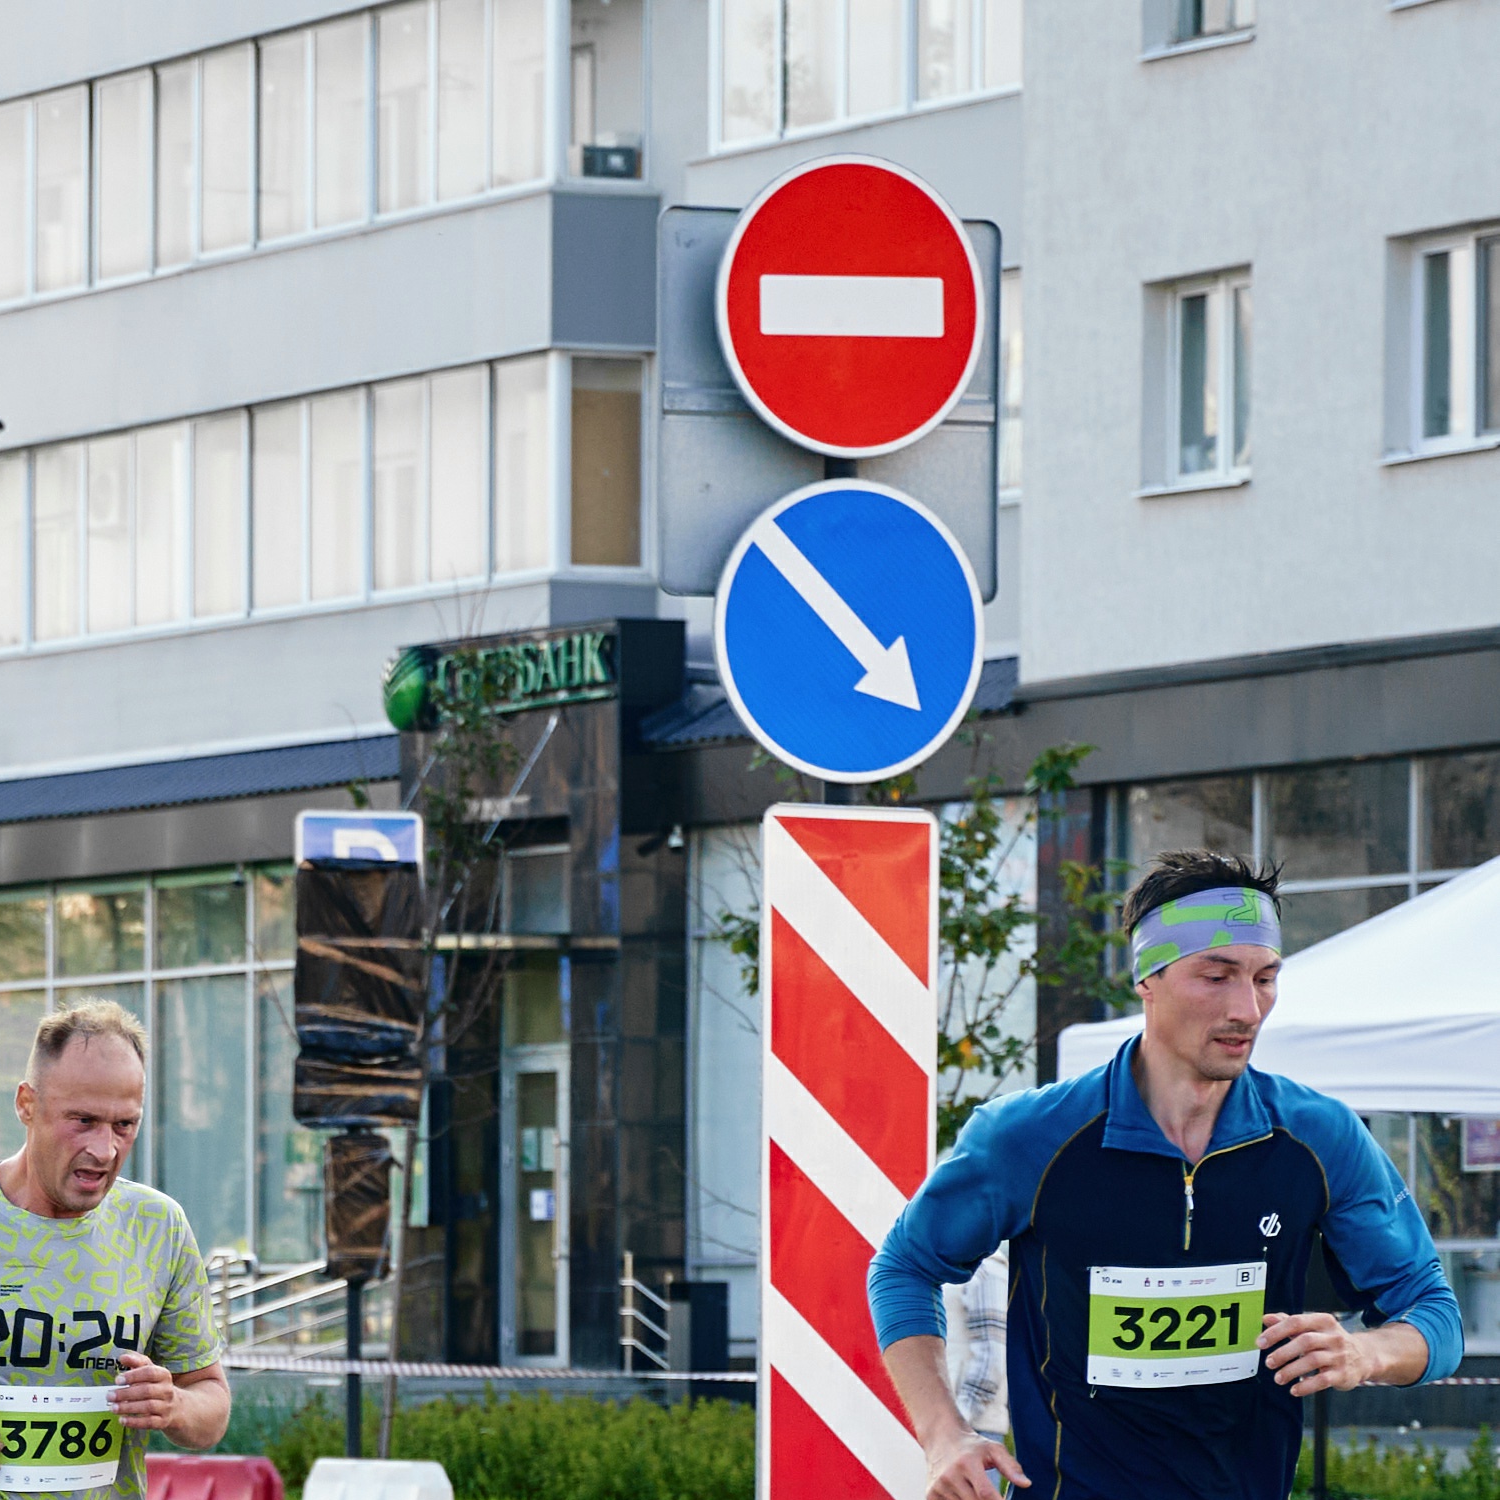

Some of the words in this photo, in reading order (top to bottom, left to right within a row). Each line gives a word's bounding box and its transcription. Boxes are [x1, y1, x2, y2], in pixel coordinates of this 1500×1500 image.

[1241, 1271, 1250, 1283] B
[1112, 1302, 1240, 1351] 3221
[0, 1419, 113, 1460] 3786
